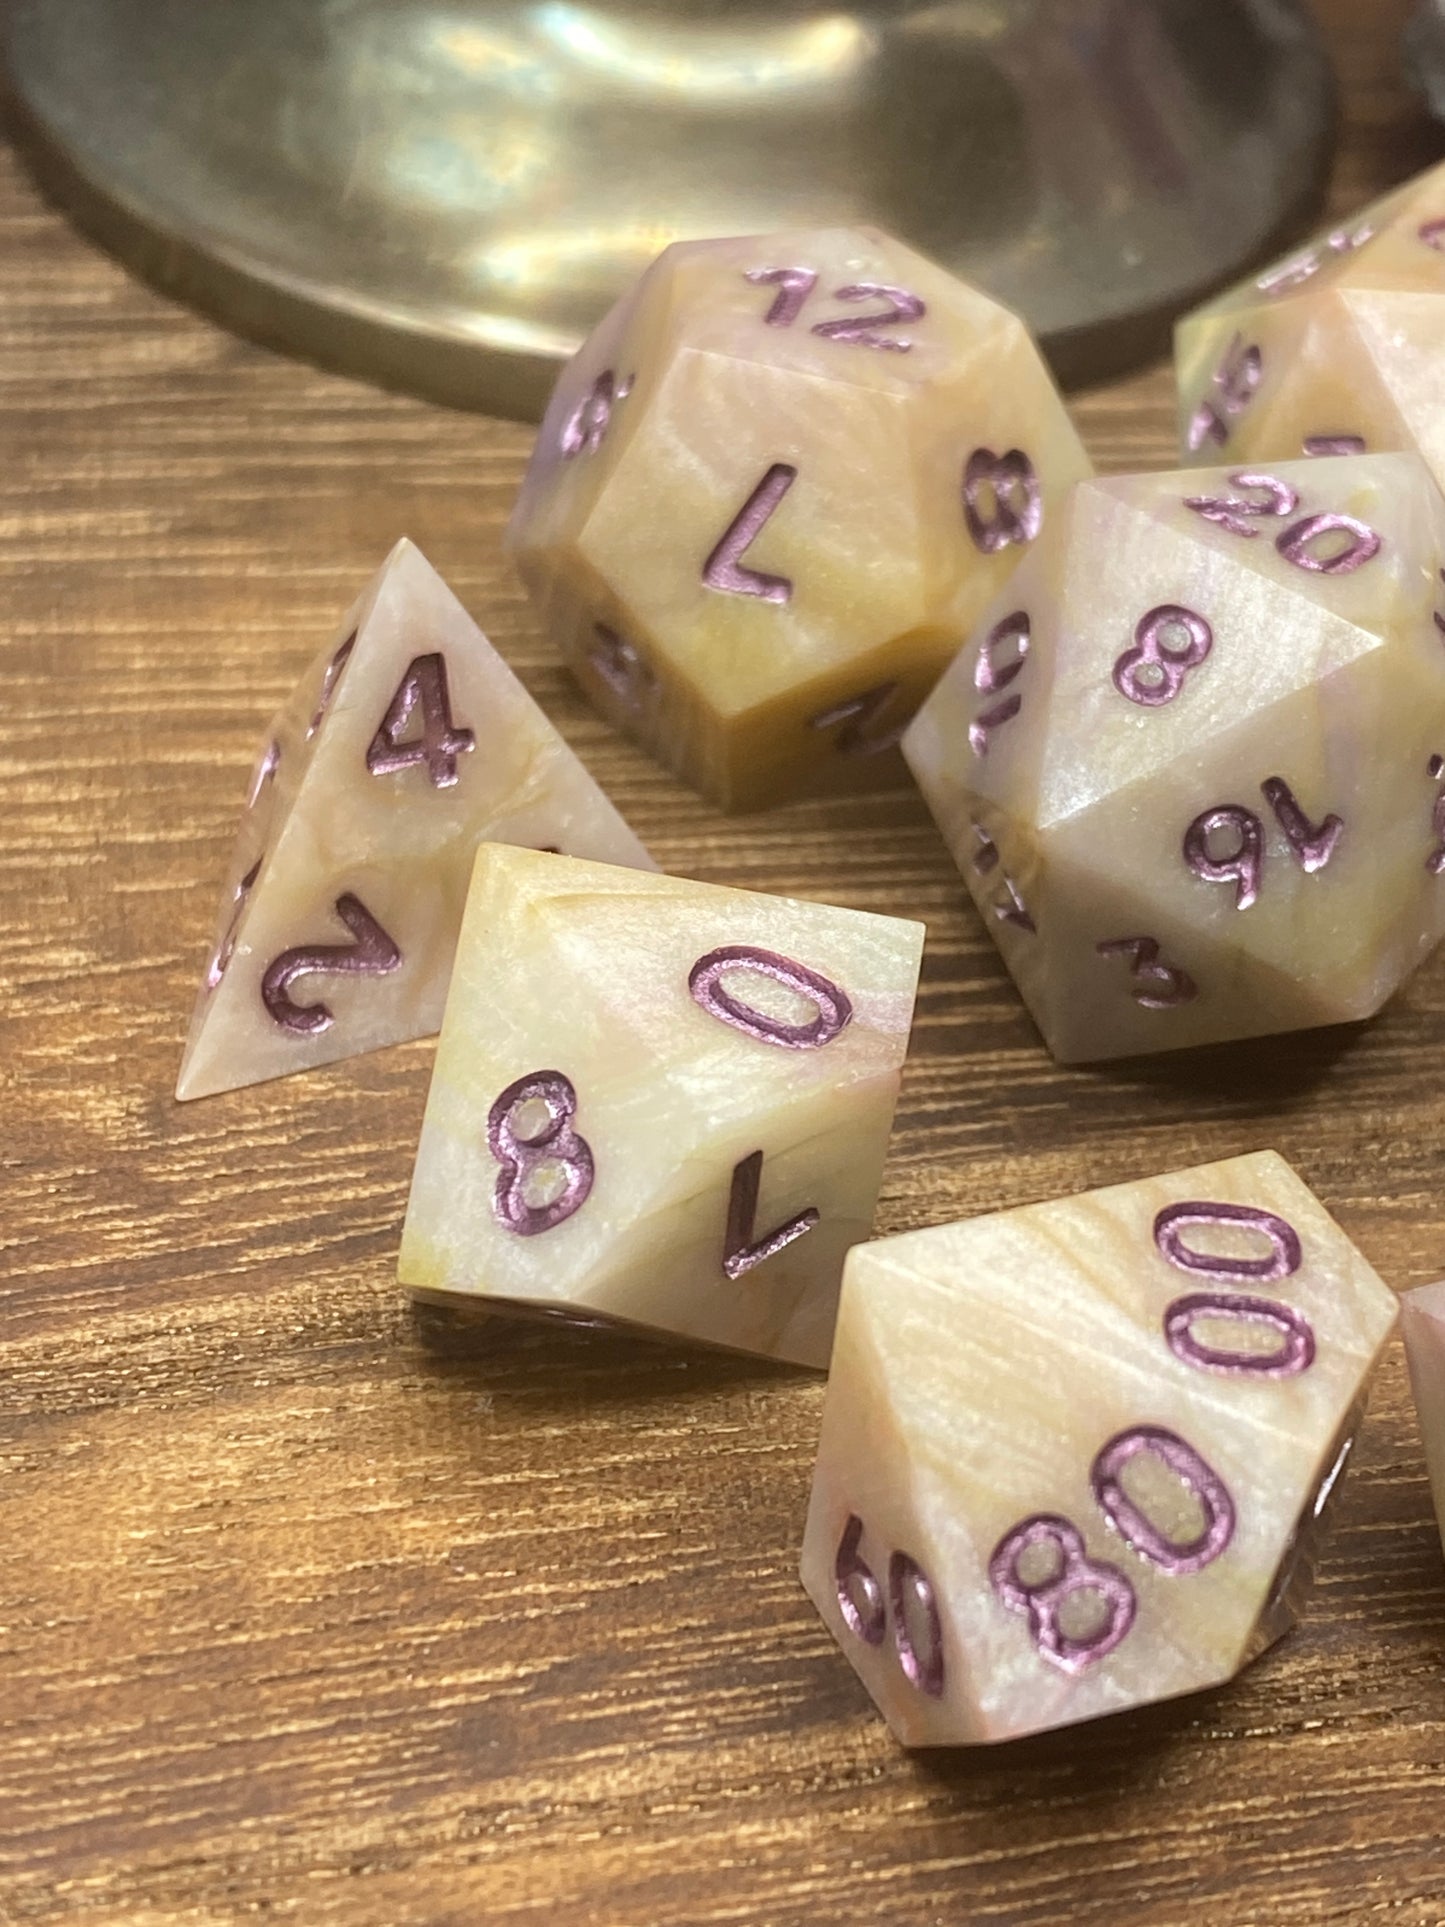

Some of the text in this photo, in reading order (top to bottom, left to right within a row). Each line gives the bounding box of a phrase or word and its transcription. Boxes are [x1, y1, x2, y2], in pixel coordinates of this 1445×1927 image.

[745, 265, 926, 353] 12
[702, 462, 798, 604] 7
[962, 447, 1042, 553] 8
[1182, 472, 1381, 575] 20
[366, 651, 476, 789] 4
[1112, 603, 1213, 706] 8
[1183, 776, 1345, 911] 16
[261, 892, 403, 1034] 2
[688, 945, 853, 1050] 0
[1096, 936, 1198, 1009] 3
[485, 1069, 595, 1237] 8
[722, 1149, 821, 1281] 7
[1153, 1201, 1316, 1380] 00
[834, 1512, 944, 1698] 60
[988, 1423, 1237, 1677] 80
